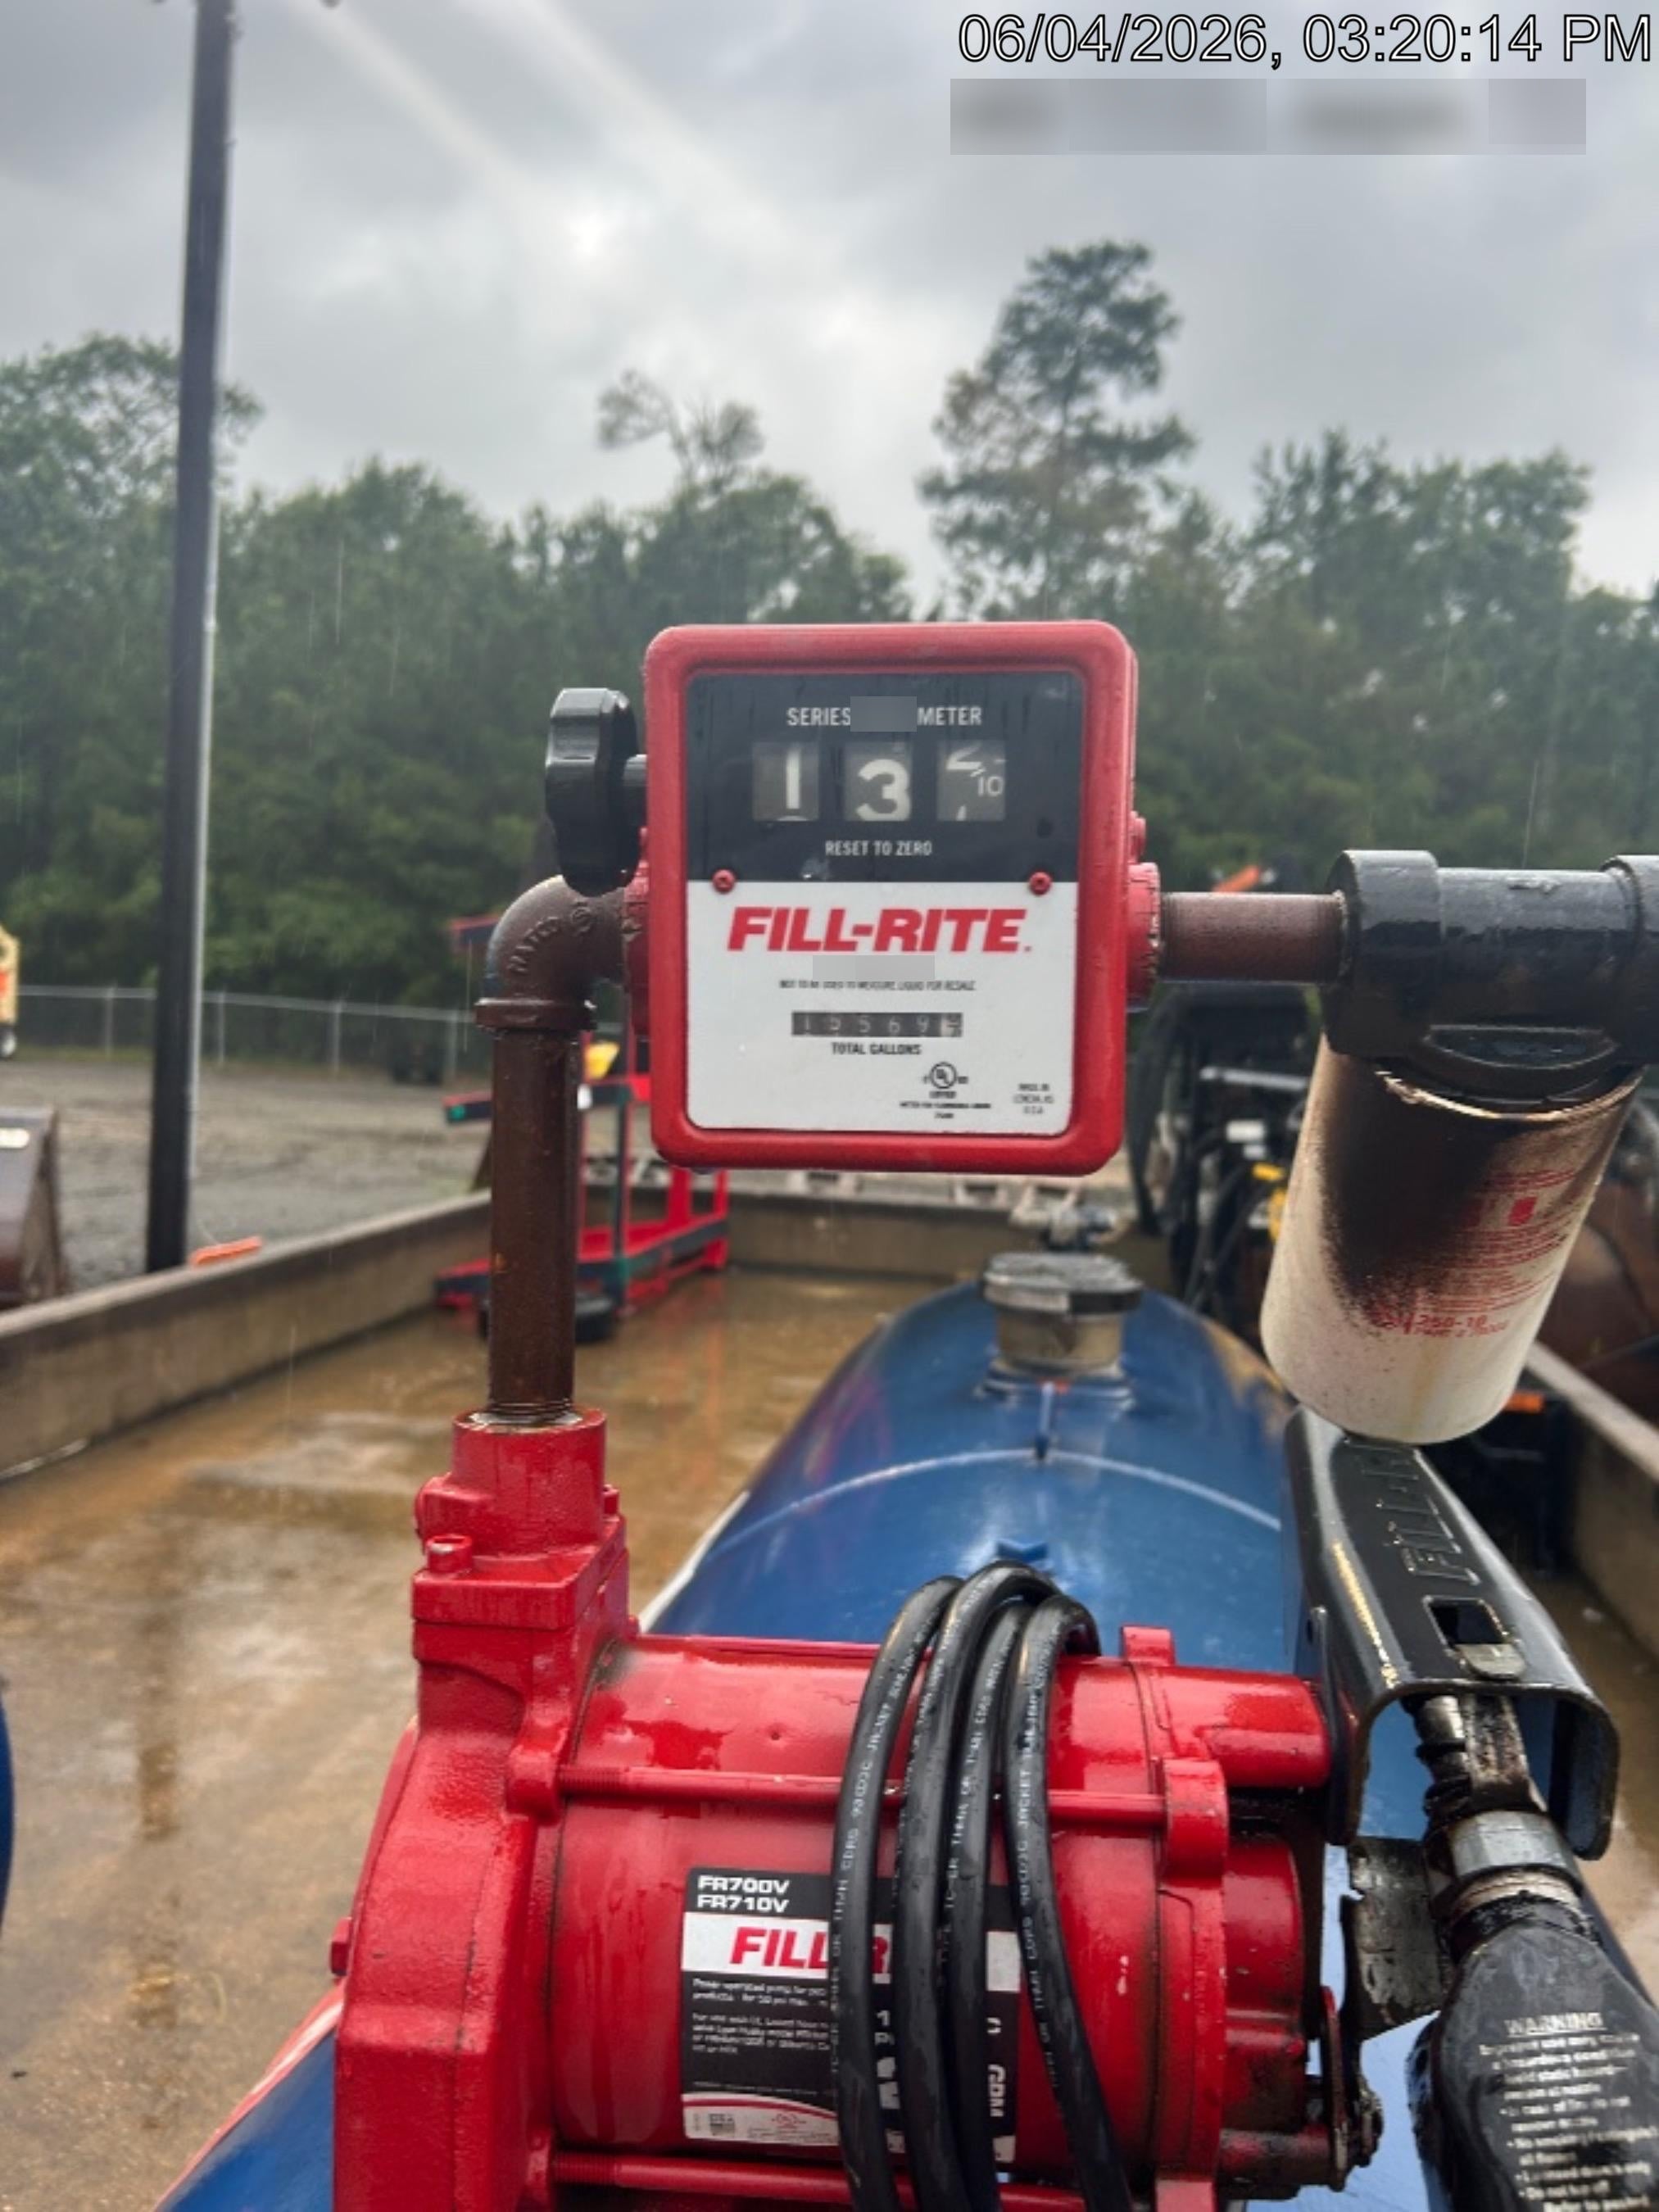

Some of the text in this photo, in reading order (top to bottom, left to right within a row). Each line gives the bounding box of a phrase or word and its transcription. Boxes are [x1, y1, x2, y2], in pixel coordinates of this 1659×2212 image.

[786, 707, 982, 727] SERIES METER
[825, 841, 932, 857] RESET TO ZERO
[726, 906, 1027, 953] FILL-RITE
[832, 1042, 921, 1055] TOTAL GALLONS
[697, 1874, 789, 1895] FR700V
[696, 1893, 789, 1913] FR710V
[1504, 2012, 1603, 2035] WARNING
